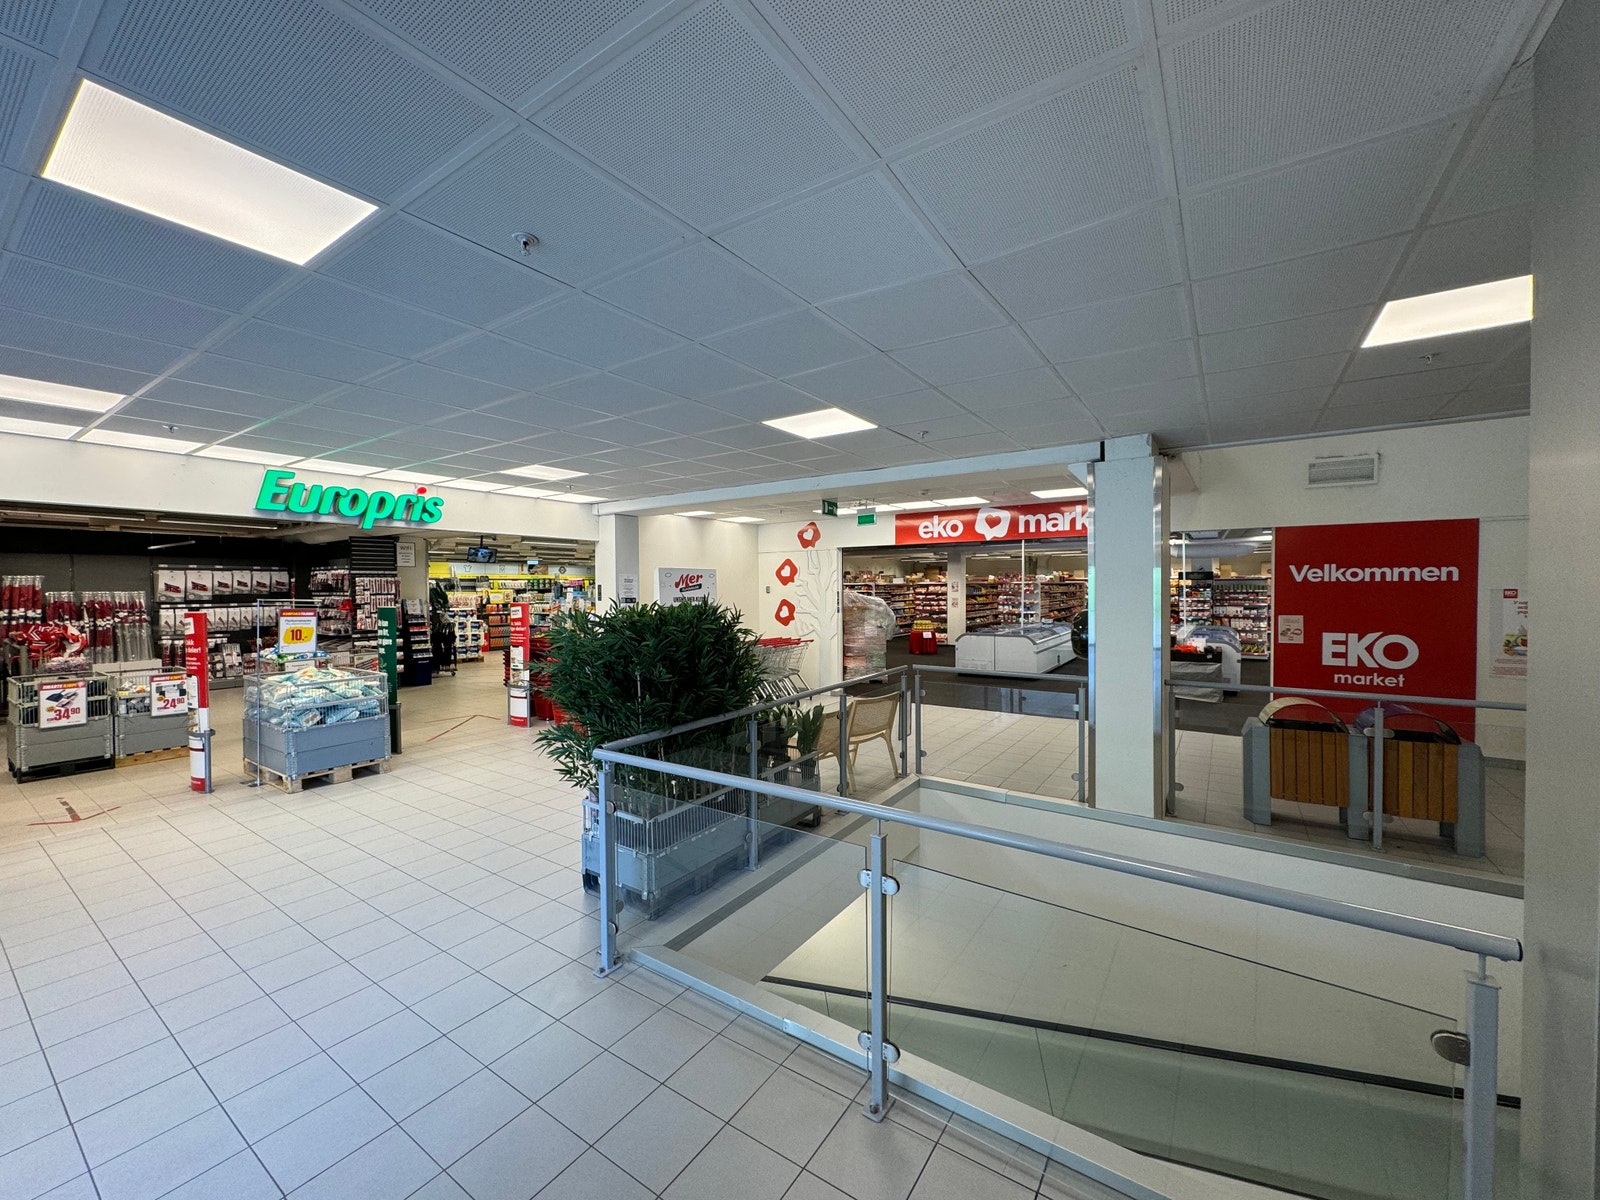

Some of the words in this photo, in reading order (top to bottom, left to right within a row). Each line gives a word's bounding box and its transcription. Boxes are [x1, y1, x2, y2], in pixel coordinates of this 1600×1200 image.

[255, 469, 445, 530] Europris
[918, 515, 964, 539] eko
[674, 573, 704, 589] Mer
[1289, 564, 1460, 583] Velkommen
[1322, 632, 1420, 669] EKO
[1333, 672, 1406, 688] market
